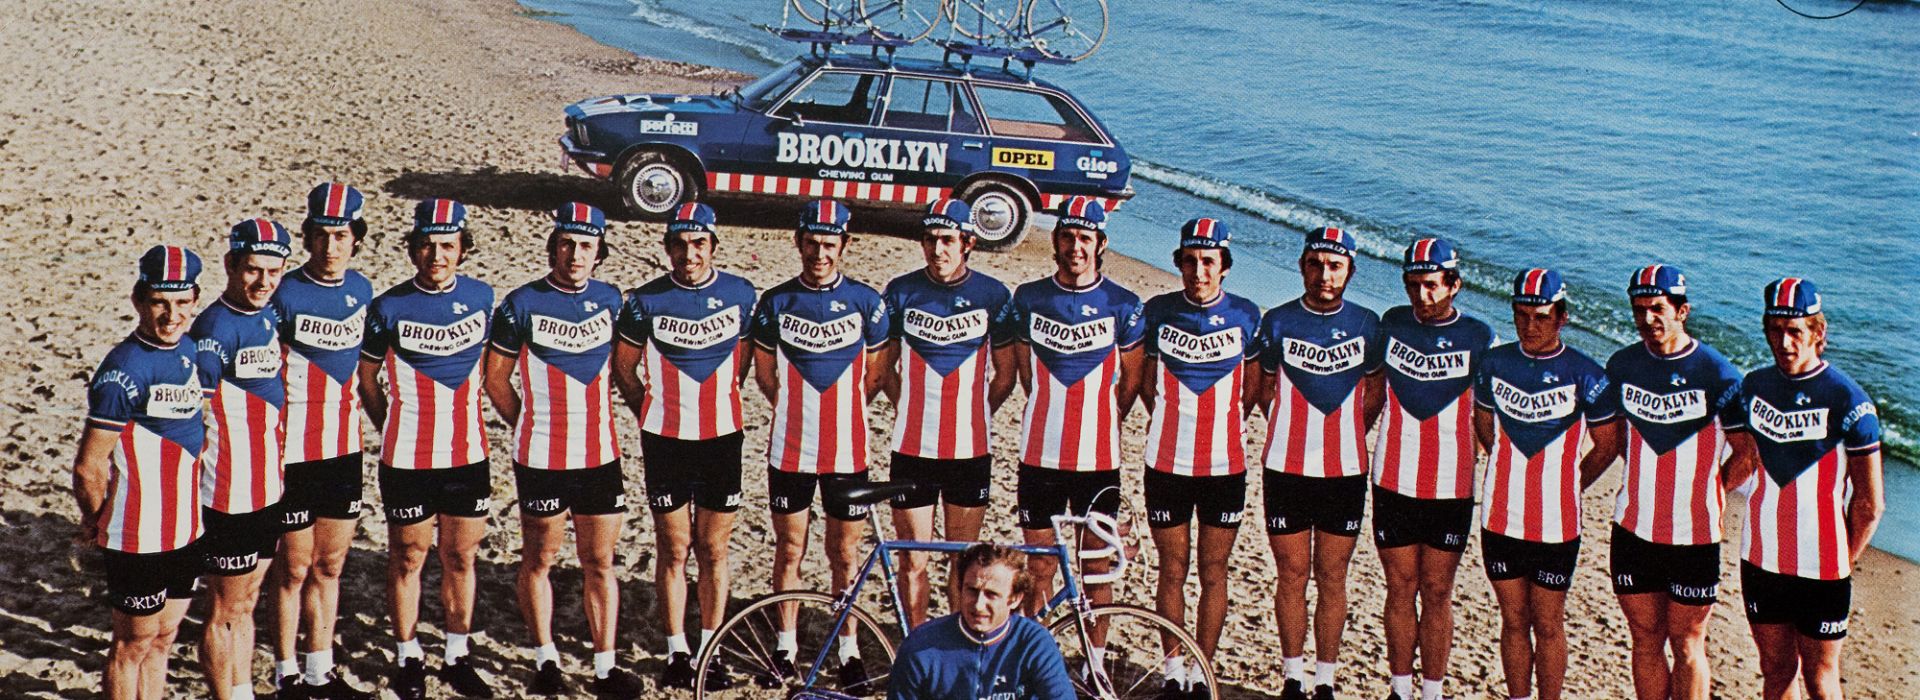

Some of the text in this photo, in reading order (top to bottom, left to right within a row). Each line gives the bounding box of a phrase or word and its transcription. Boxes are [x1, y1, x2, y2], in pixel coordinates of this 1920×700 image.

[776, 132, 949, 173] BROOKLYN
[999, 151, 1048, 166] OPEL
[818, 169, 894, 182] CHEWING GUM
[1076, 156, 1118, 173] Gios
[402, 318, 482, 341] BROOKLYN
[538, 317, 608, 339] BROOKLYN
[659, 312, 735, 336] BROOKLYN
[782, 315, 856, 338] BROOKLYN
[906, 311, 981, 332] BROOKLYN
[1033, 317, 1107, 341] BROOKLYN
[793, 336, 827, 349] CHEWING
[918, 330, 950, 342] CHEWING
[1161, 326, 1235, 350] BROOKLYN
[1288, 341, 1361, 363] BROOKLYN
[1390, 341, 1464, 370] BROOKLYN
[1494, 382, 1567, 410] BROOKLYN
[1625, 387, 1699, 411] BROOKLYN
[1752, 399, 1821, 429] BROOKLYN
